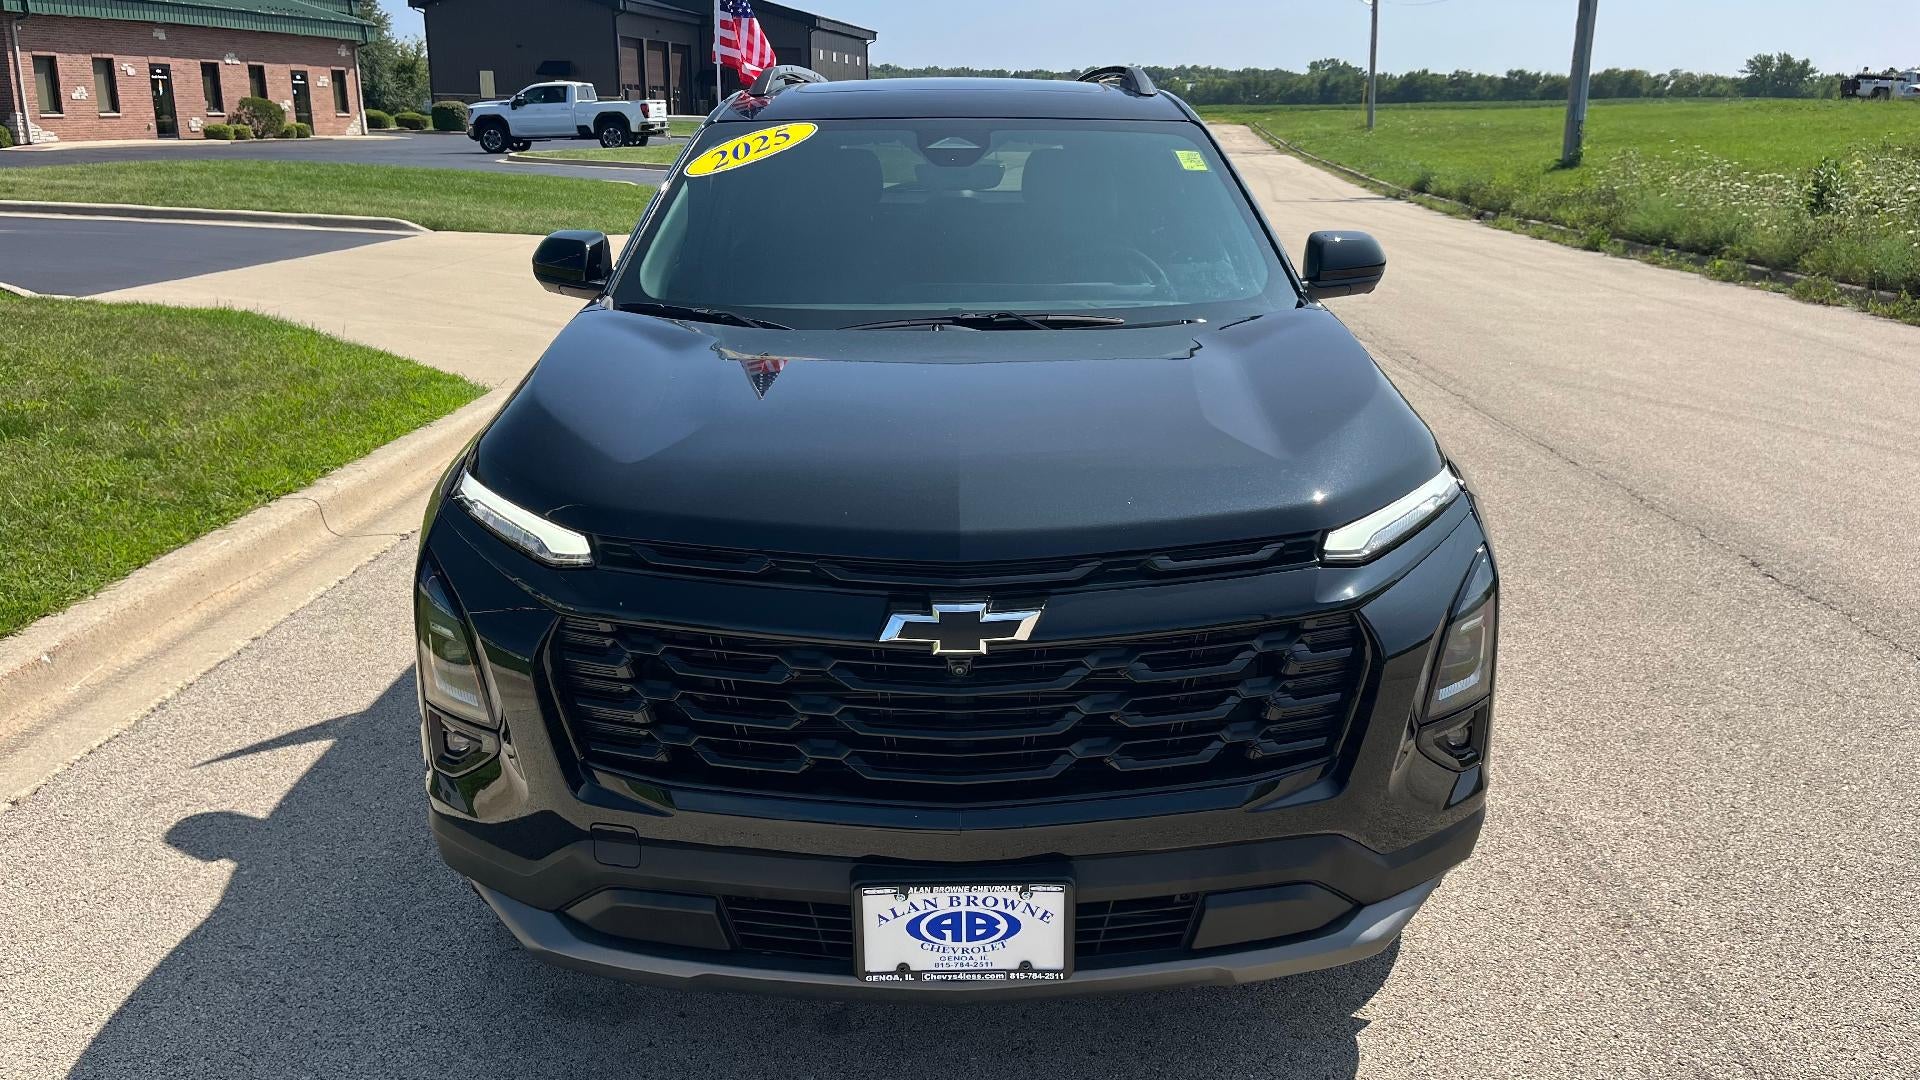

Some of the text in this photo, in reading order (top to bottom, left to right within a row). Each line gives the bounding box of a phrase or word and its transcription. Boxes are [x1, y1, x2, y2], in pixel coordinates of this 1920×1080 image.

[711, 128, 791, 170] 2025
[908, 885, 1022, 894] ALAN BROWNE CHEVROLET
[877, 895, 1054, 927] ALAN BROWNE
[926, 911, 1001, 942] AB
[920, 941, 1007, 955] CHEVROLET
[865, 973, 914, 982] GENOA, IL
[923, 972, 1004, 981] Chevys4less.com
[1009, 972, 1064, 980] 815-784-2511
